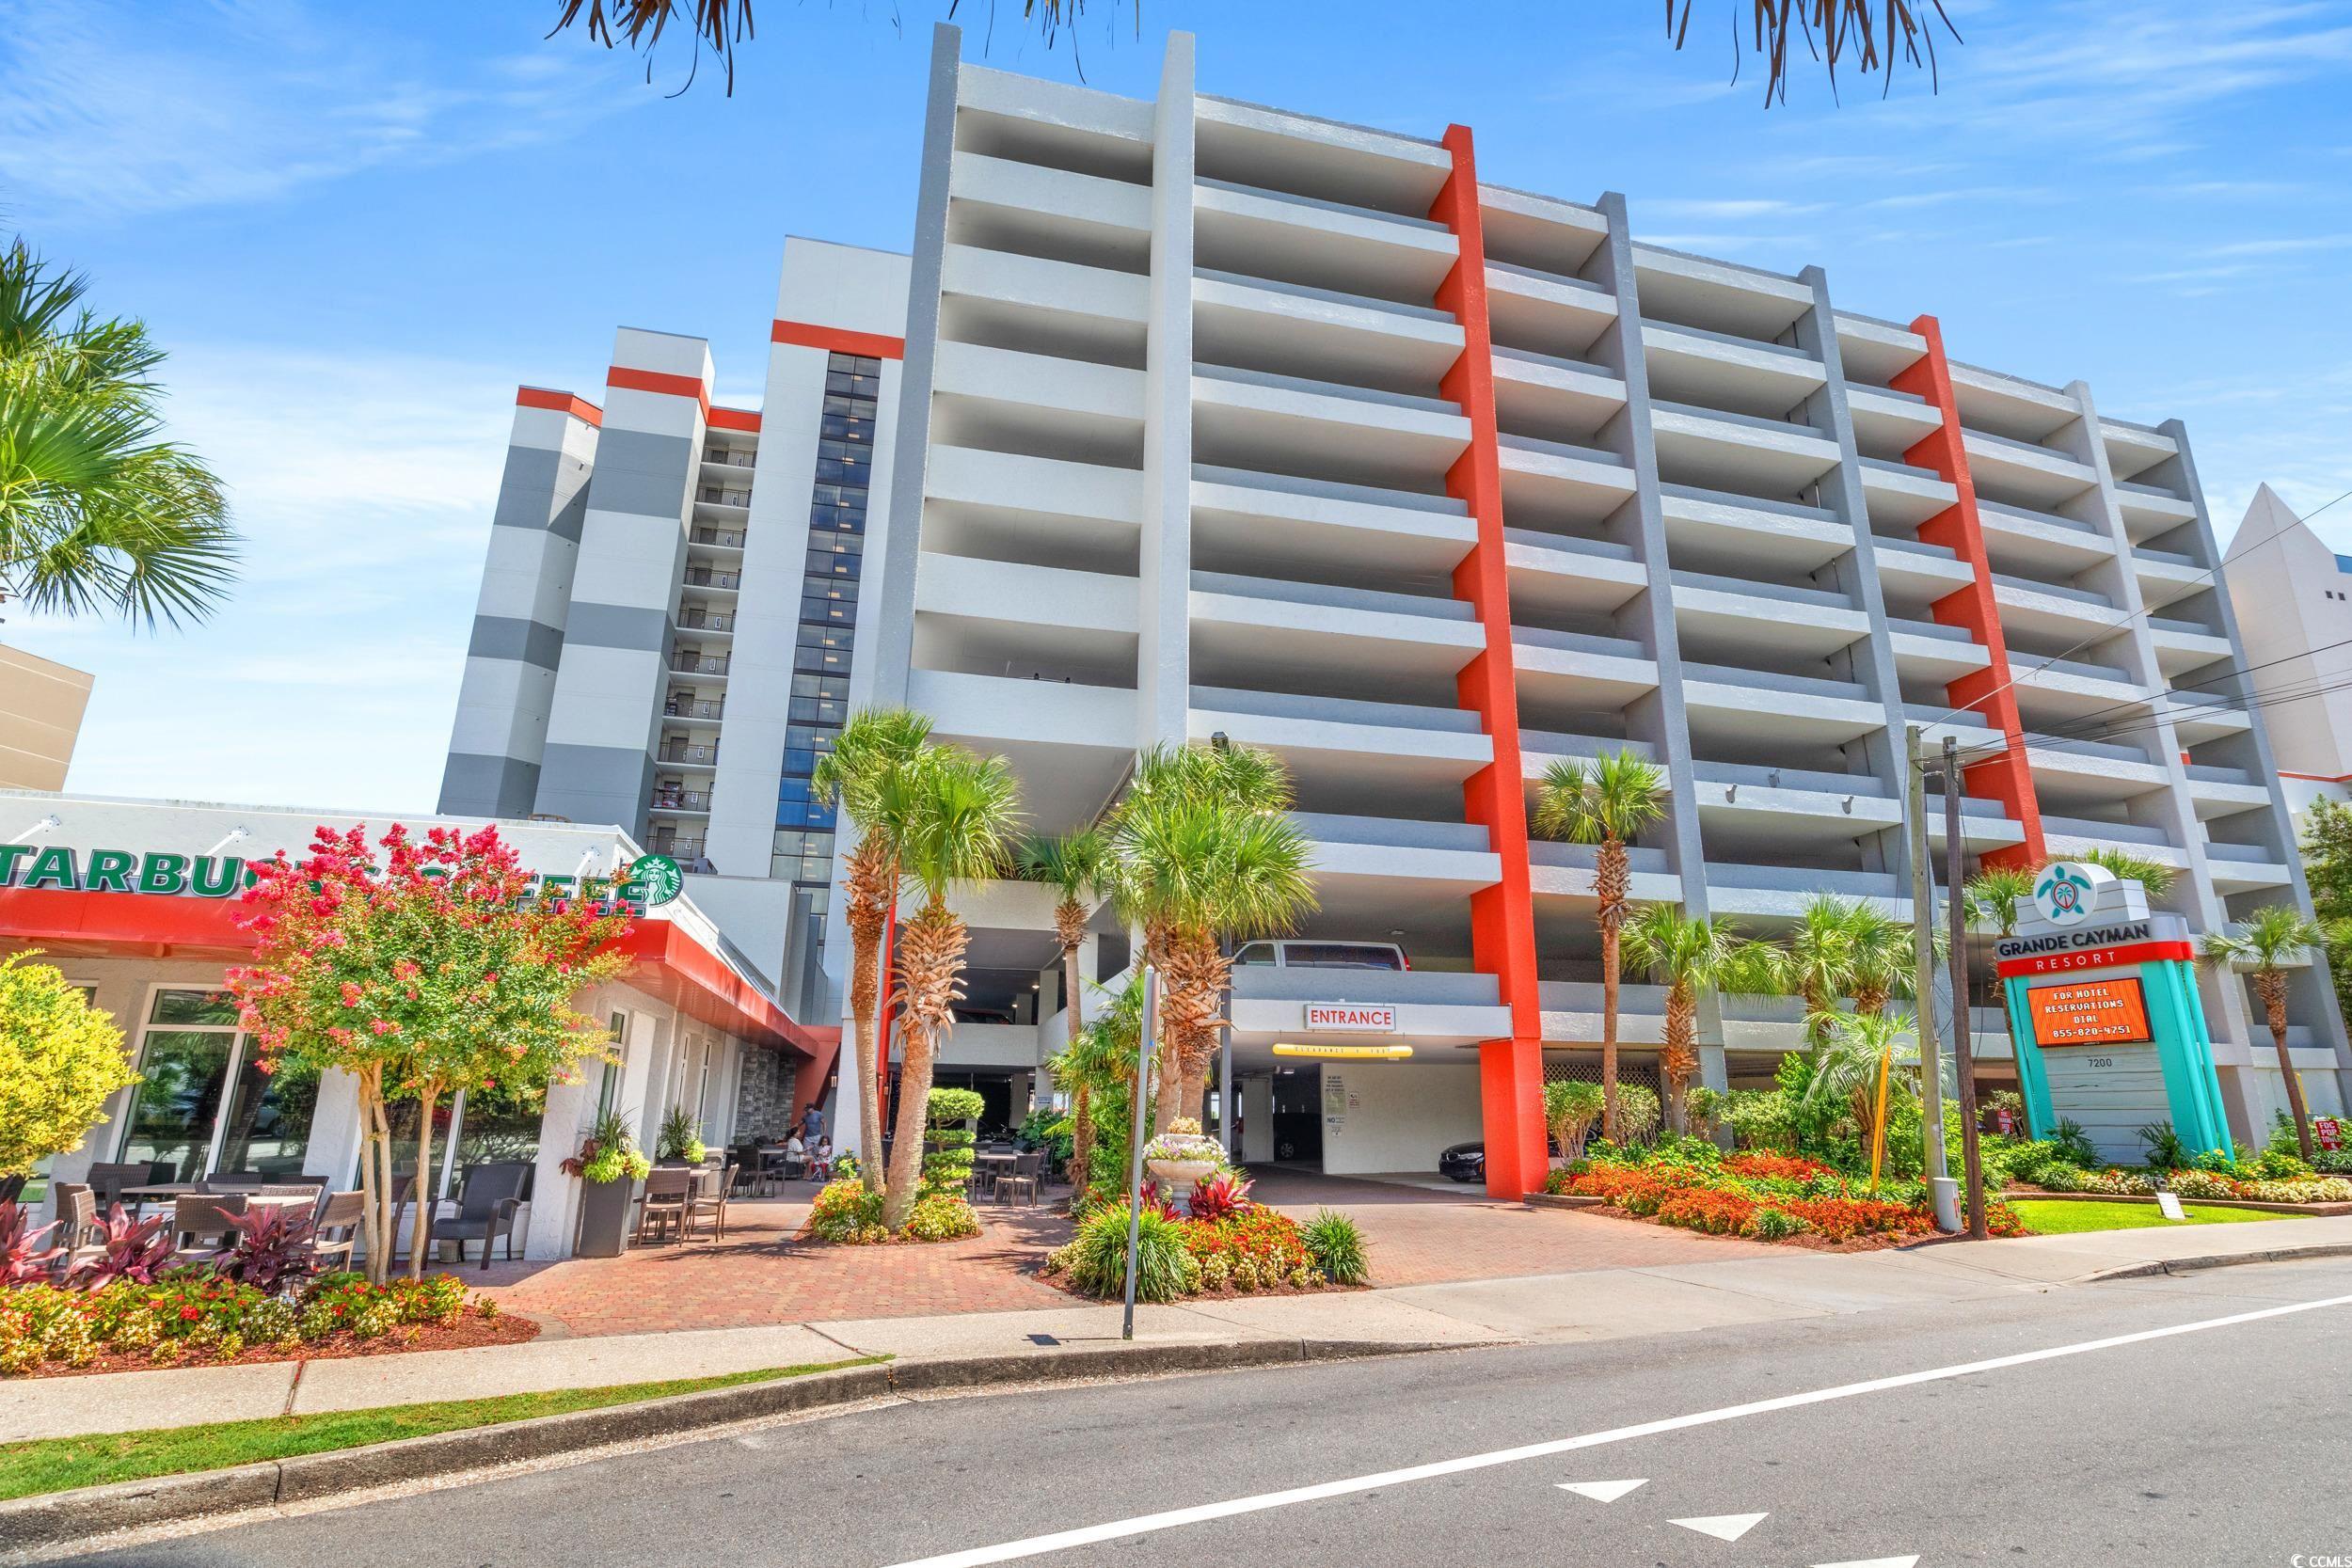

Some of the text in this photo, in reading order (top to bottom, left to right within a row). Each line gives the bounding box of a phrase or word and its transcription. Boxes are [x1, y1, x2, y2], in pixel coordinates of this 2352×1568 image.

[1999, 924, 2151, 957] GRANDE CAYMAN
[2036, 951, 2115, 971] RESORT
[2053, 988, 2109, 1001] FOR HOTEL
[2044, 999, 2124, 1014] RESERVATIONS
[1311, 1009, 1391, 1025] ENTRANCE
[2074, 1015, 2100, 1024] DIAL
[2053, 1025, 2131, 1038] 855-820-4751
[2088, 1058, 2112, 1068] 7200
